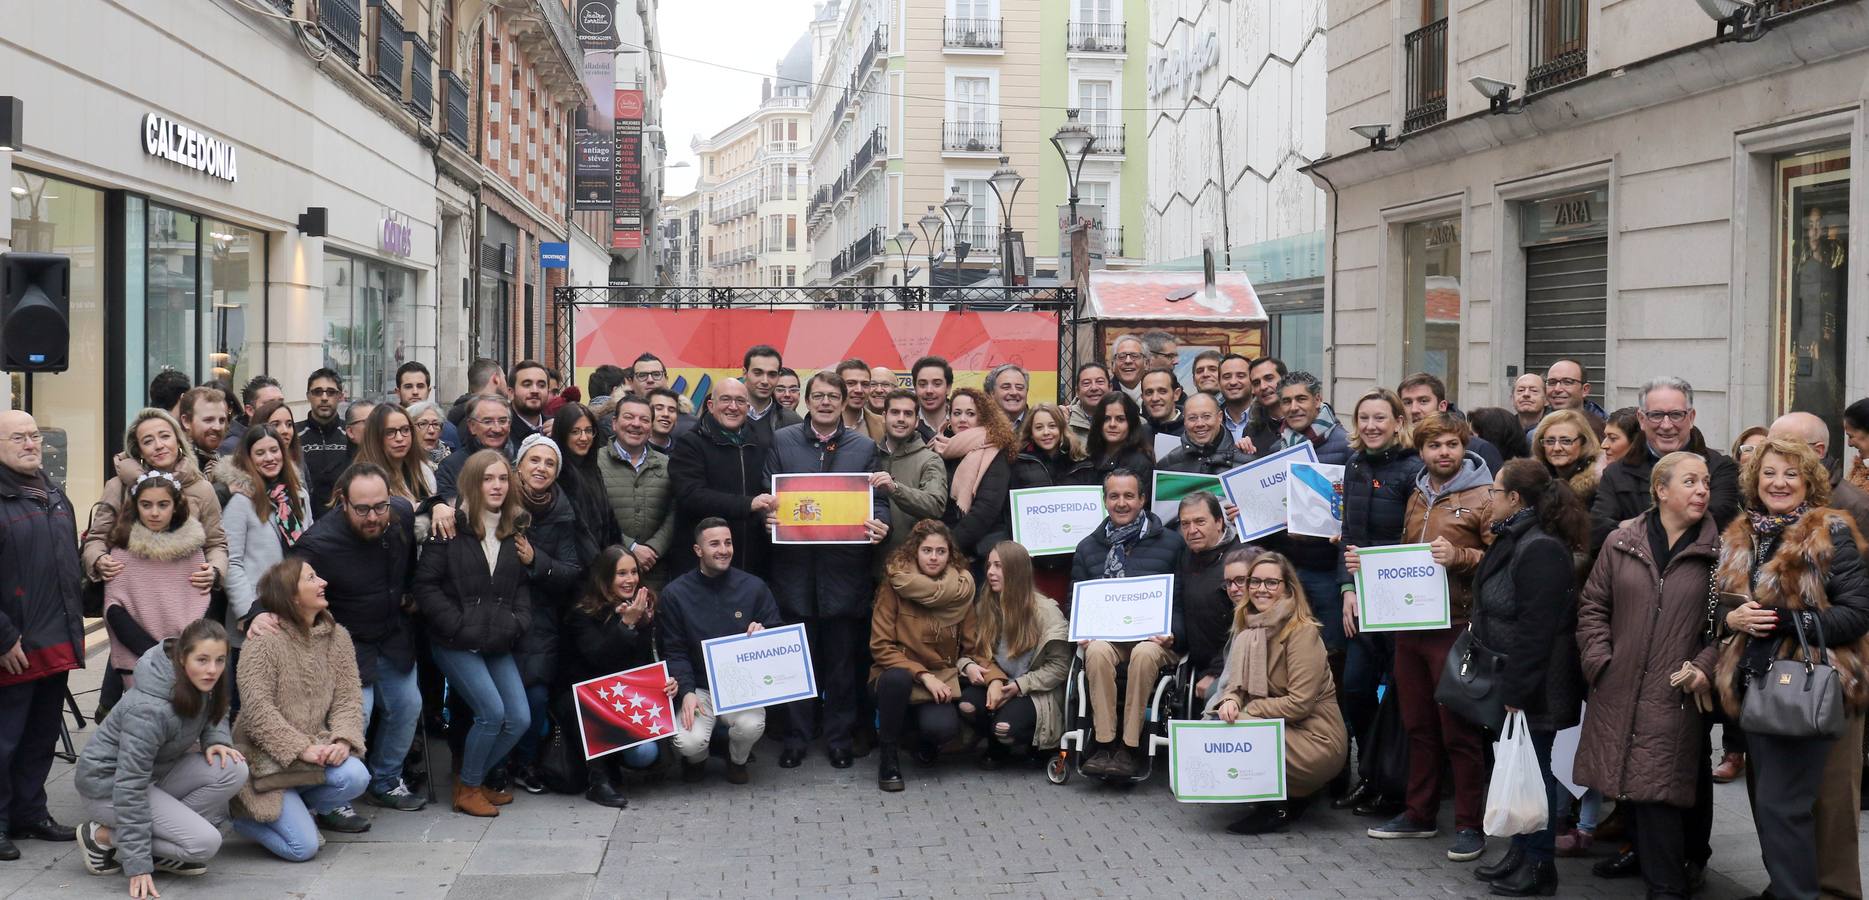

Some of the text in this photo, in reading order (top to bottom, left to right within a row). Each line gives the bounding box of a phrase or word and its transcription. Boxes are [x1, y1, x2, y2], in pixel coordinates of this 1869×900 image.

[142, 112, 238, 182] CALZEDONIA
[1554, 200, 1592, 225] ZARA
[1430, 224, 1458, 246] ZARA
[896, 378, 912, 387] 78
[1026, 502, 1097, 515] PROSPERIDAD
[1378, 565, 1435, 580] PROGRESO
[1104, 590, 1163, 602] DIVERSIDAD
[736, 643, 802, 663] HERMANDAD
[1204, 742, 1253, 753] UNIDAD
